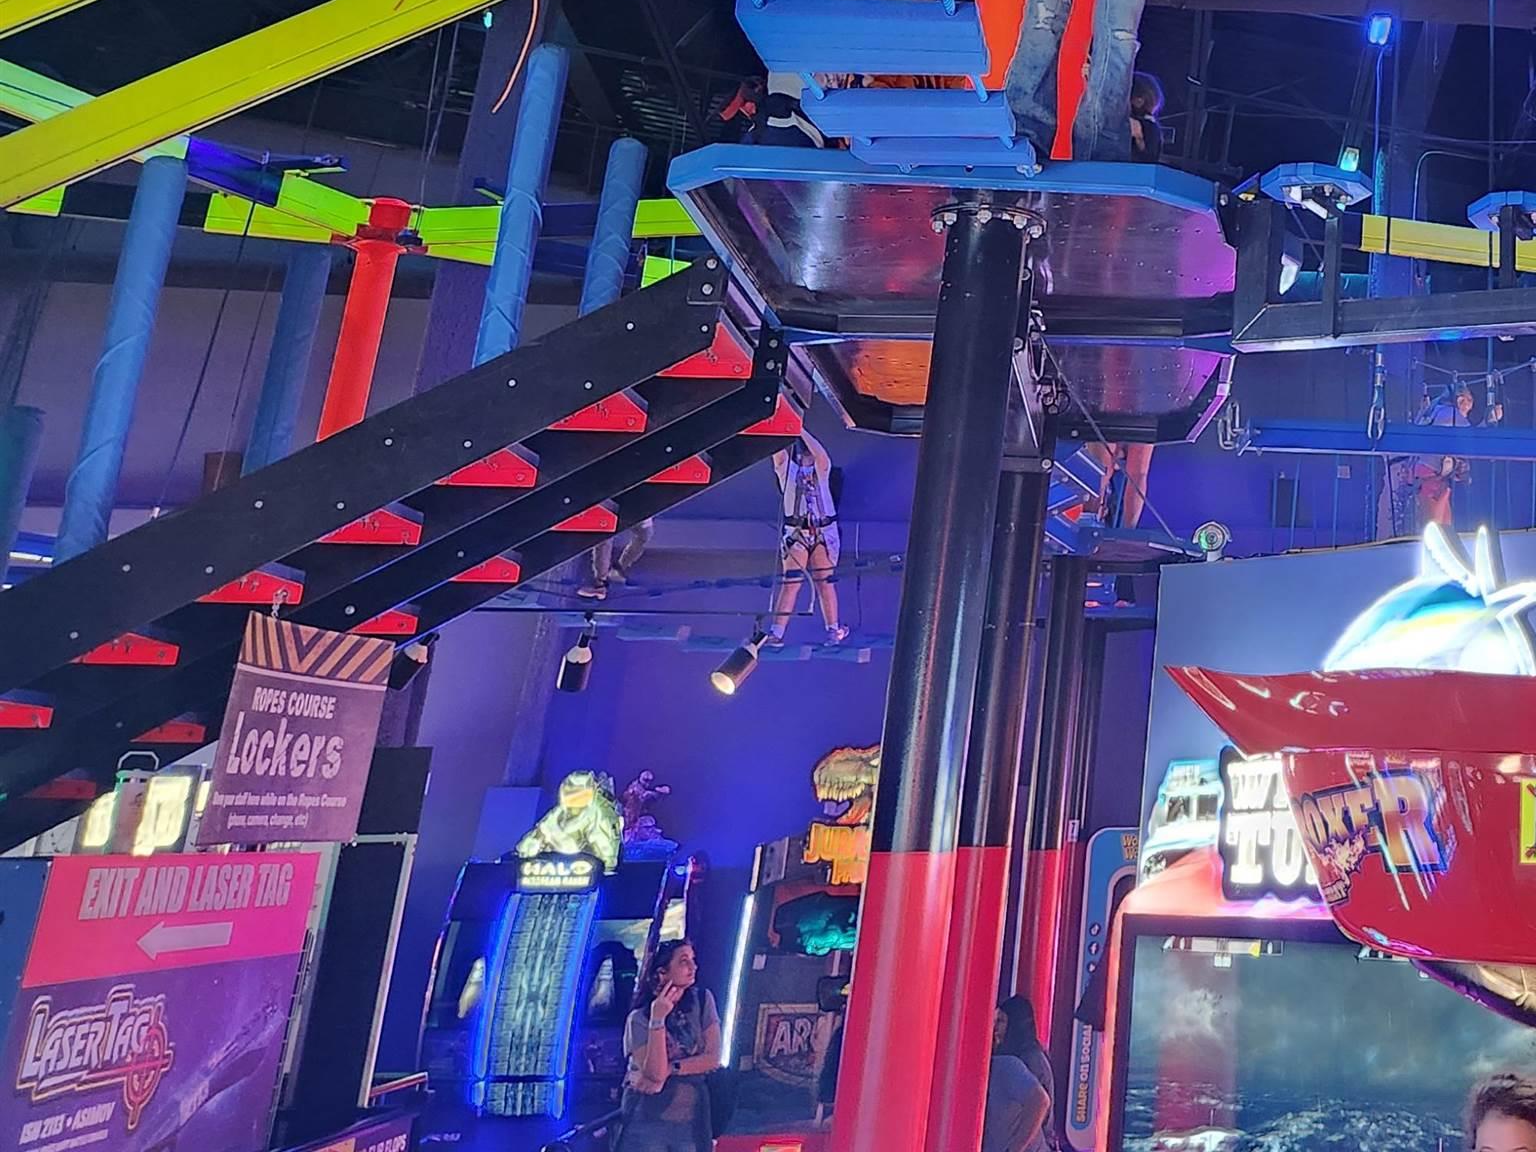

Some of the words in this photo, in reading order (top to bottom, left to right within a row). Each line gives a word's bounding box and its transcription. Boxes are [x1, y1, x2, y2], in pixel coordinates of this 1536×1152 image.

[252, 686, 287, 714] ROPES
[287, 692, 337, 719] COURSE
[226, 711, 344, 779] Lockers
[1296, 774, 1442, 867] OXER
[78, 867, 140, 920] EXIT
[133, 865, 190, 916] AND
[187, 864, 255, 912] LASER
[254, 862, 294, 908] TAG
[523, 860, 593, 876] HALO
[21, 1013, 106, 1080] LASER
[103, 1000, 150, 1064] TAG
